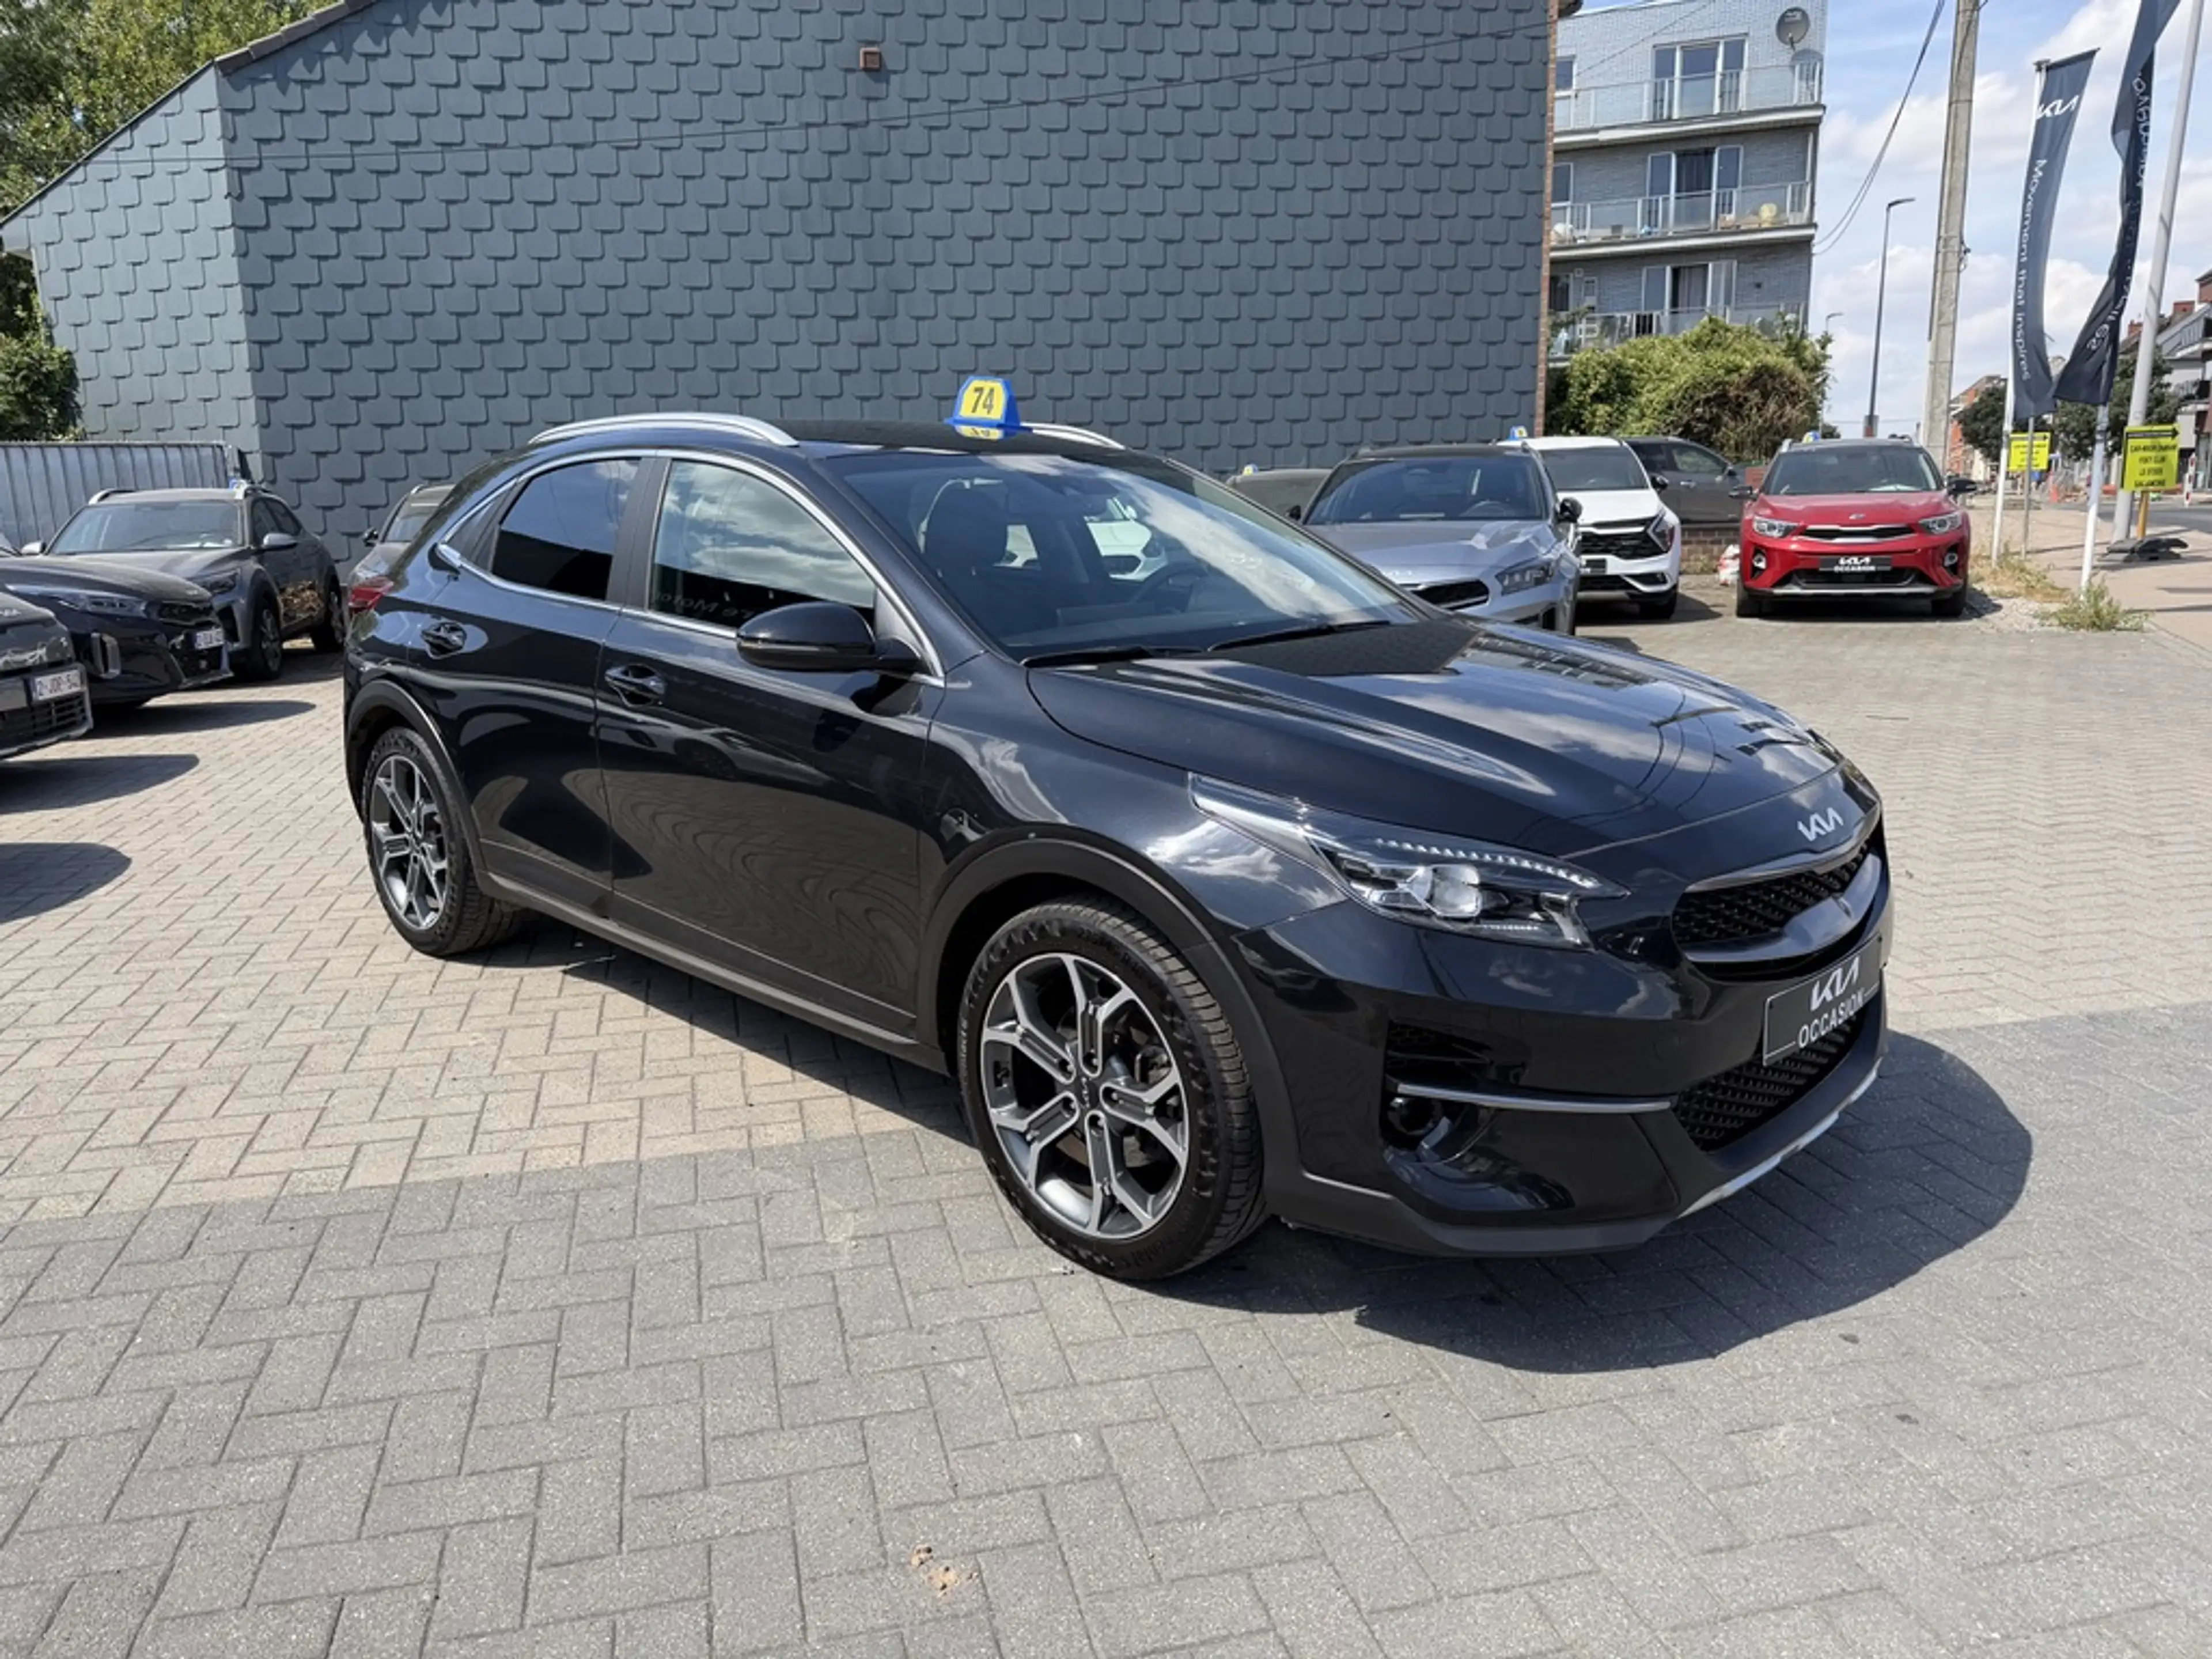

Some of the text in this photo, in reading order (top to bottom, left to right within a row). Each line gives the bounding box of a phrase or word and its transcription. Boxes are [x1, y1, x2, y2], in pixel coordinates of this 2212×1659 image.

[2037, 94, 2079, 119] KIA
[2015, 159, 2048, 381] Movement that inspires
[971, 387, 995, 415] 74
[1839, 556, 1871, 565] KIA
[1797, 807, 1843, 842] KIA
[1809, 955, 1860, 1012] KIA
[1797, 987, 1865, 1049] OCCASION
